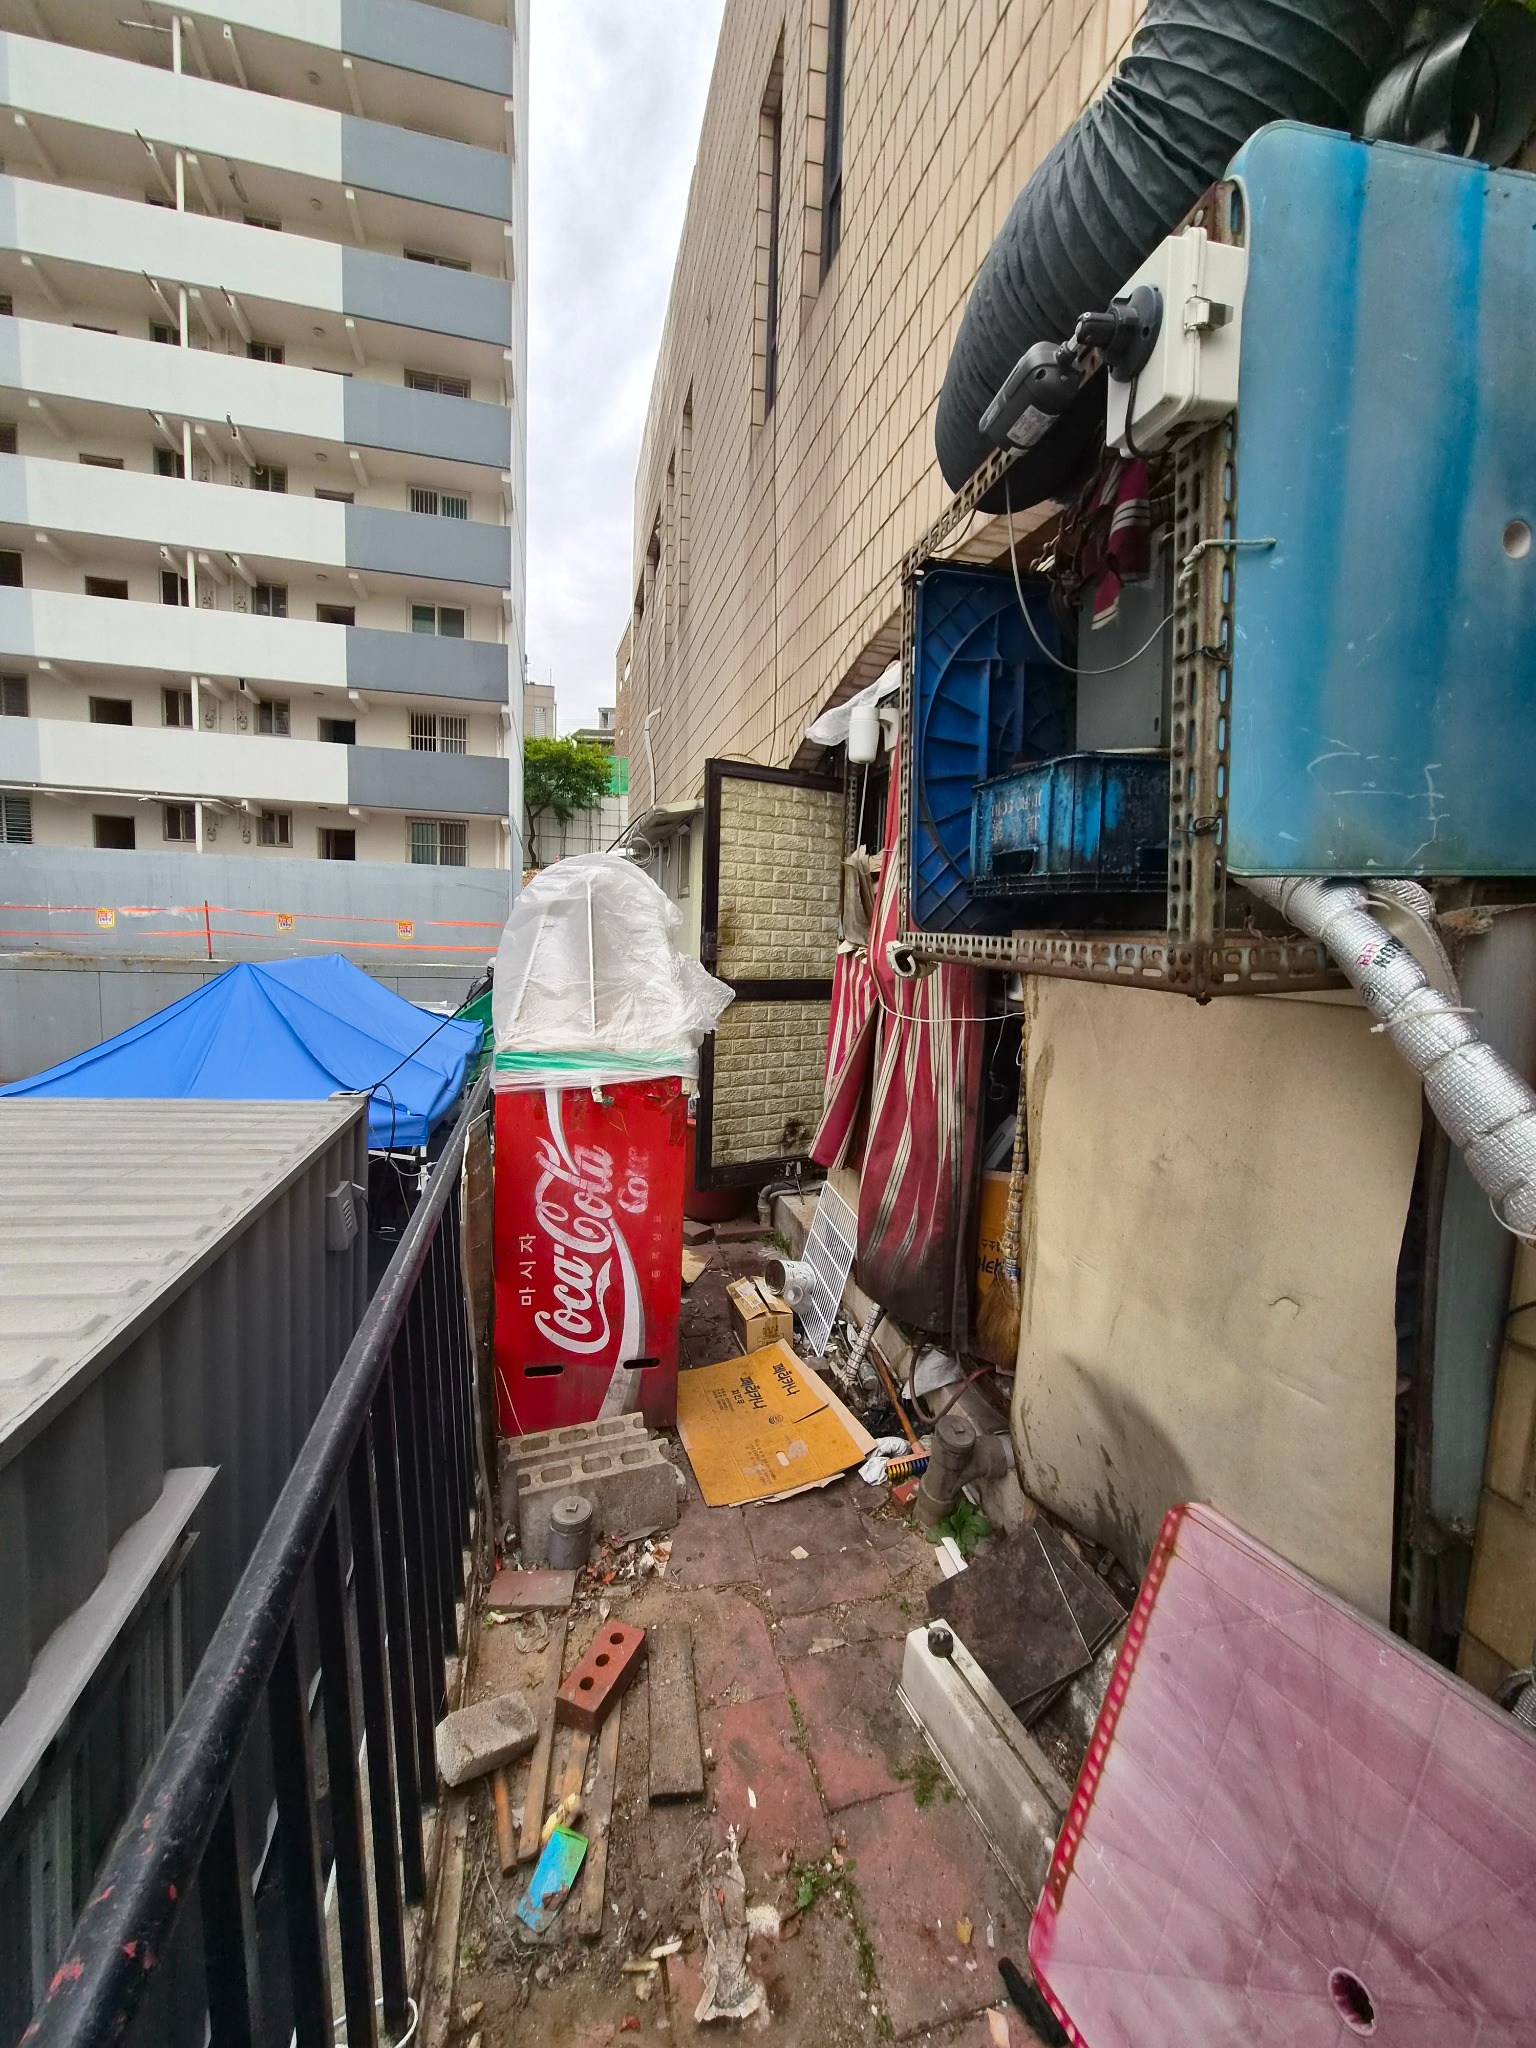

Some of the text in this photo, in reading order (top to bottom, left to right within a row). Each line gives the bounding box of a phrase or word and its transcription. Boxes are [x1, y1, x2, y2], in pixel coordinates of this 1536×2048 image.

[518, 1233, 537, 1306] 마시자
[534, 1136, 614, 1354] Coca-Cola
[740, 1374, 768, 1410] 페리카나
[772, 1362, 800, 1397] 페리카나
